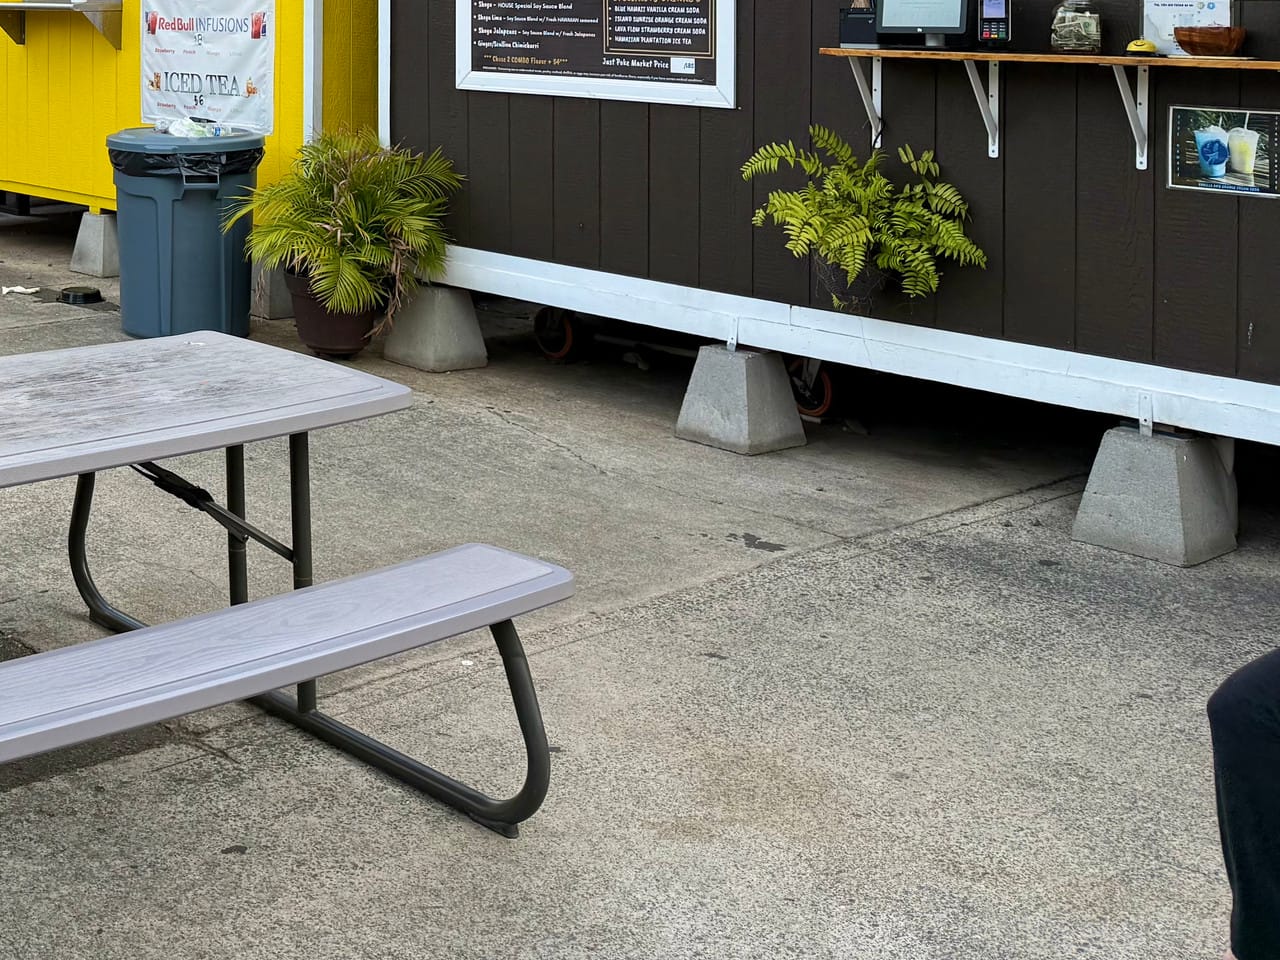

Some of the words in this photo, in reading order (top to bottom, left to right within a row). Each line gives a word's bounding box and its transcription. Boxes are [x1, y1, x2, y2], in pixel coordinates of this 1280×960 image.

[195, 18, 248, 32] INFUSIONS
[602, 57, 615, 66] Just
[616, 58, 630, 67] Poke
[630, 59, 652, 68] Market
[654, 60, 669, 69] Price
[164, 72, 202, 93] ICED
[206, 74, 240, 96] TEA
